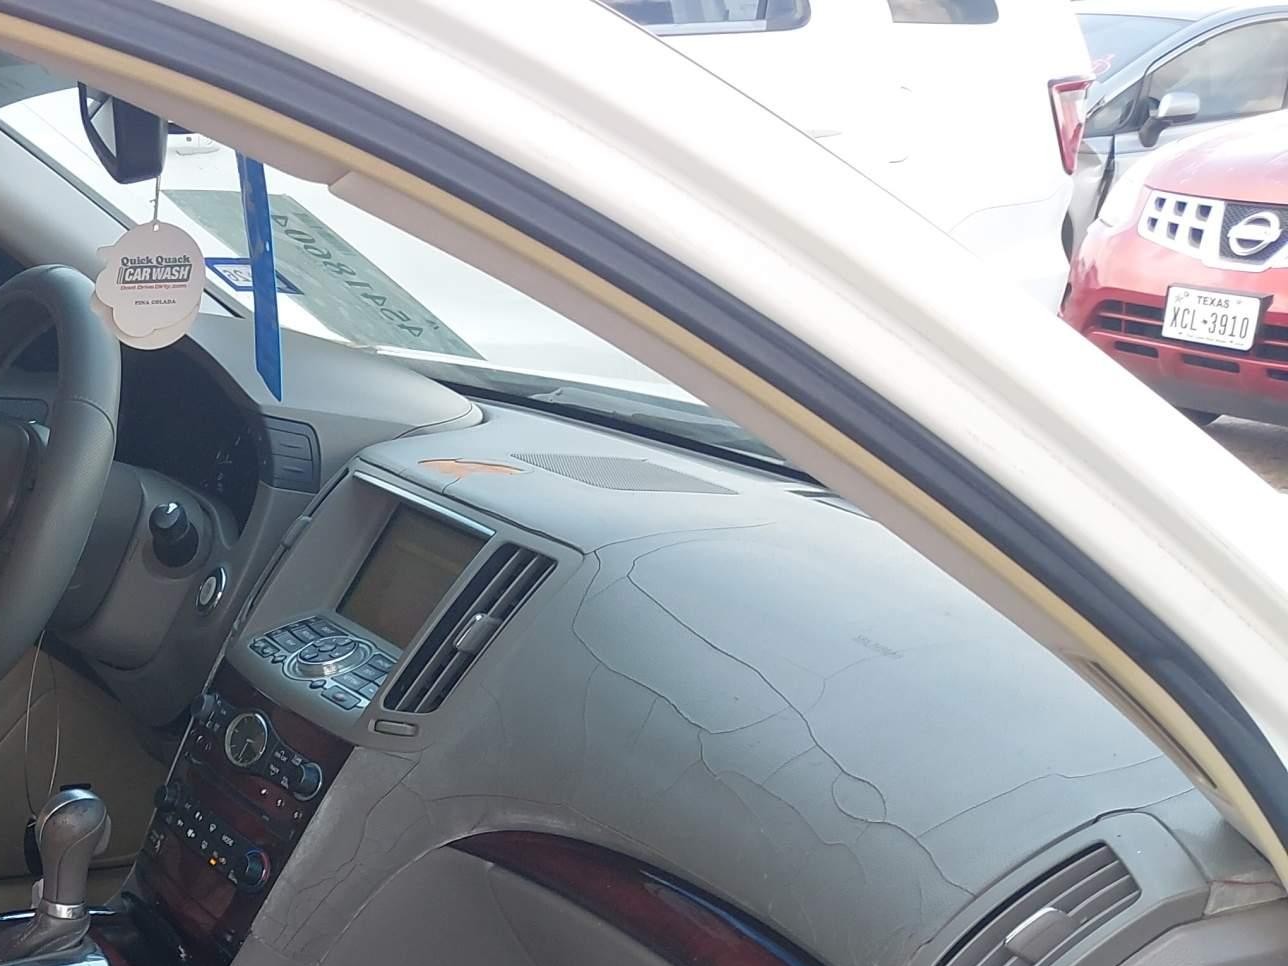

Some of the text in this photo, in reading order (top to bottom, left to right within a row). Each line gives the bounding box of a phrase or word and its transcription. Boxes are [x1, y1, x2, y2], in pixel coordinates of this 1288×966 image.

[120, 254, 190, 266] Quick Quack
[124, 266, 190, 281] CAR WASH
[1197, 295, 1230, 309] TEXAS
[1208, 312, 1249, 339] 3910
